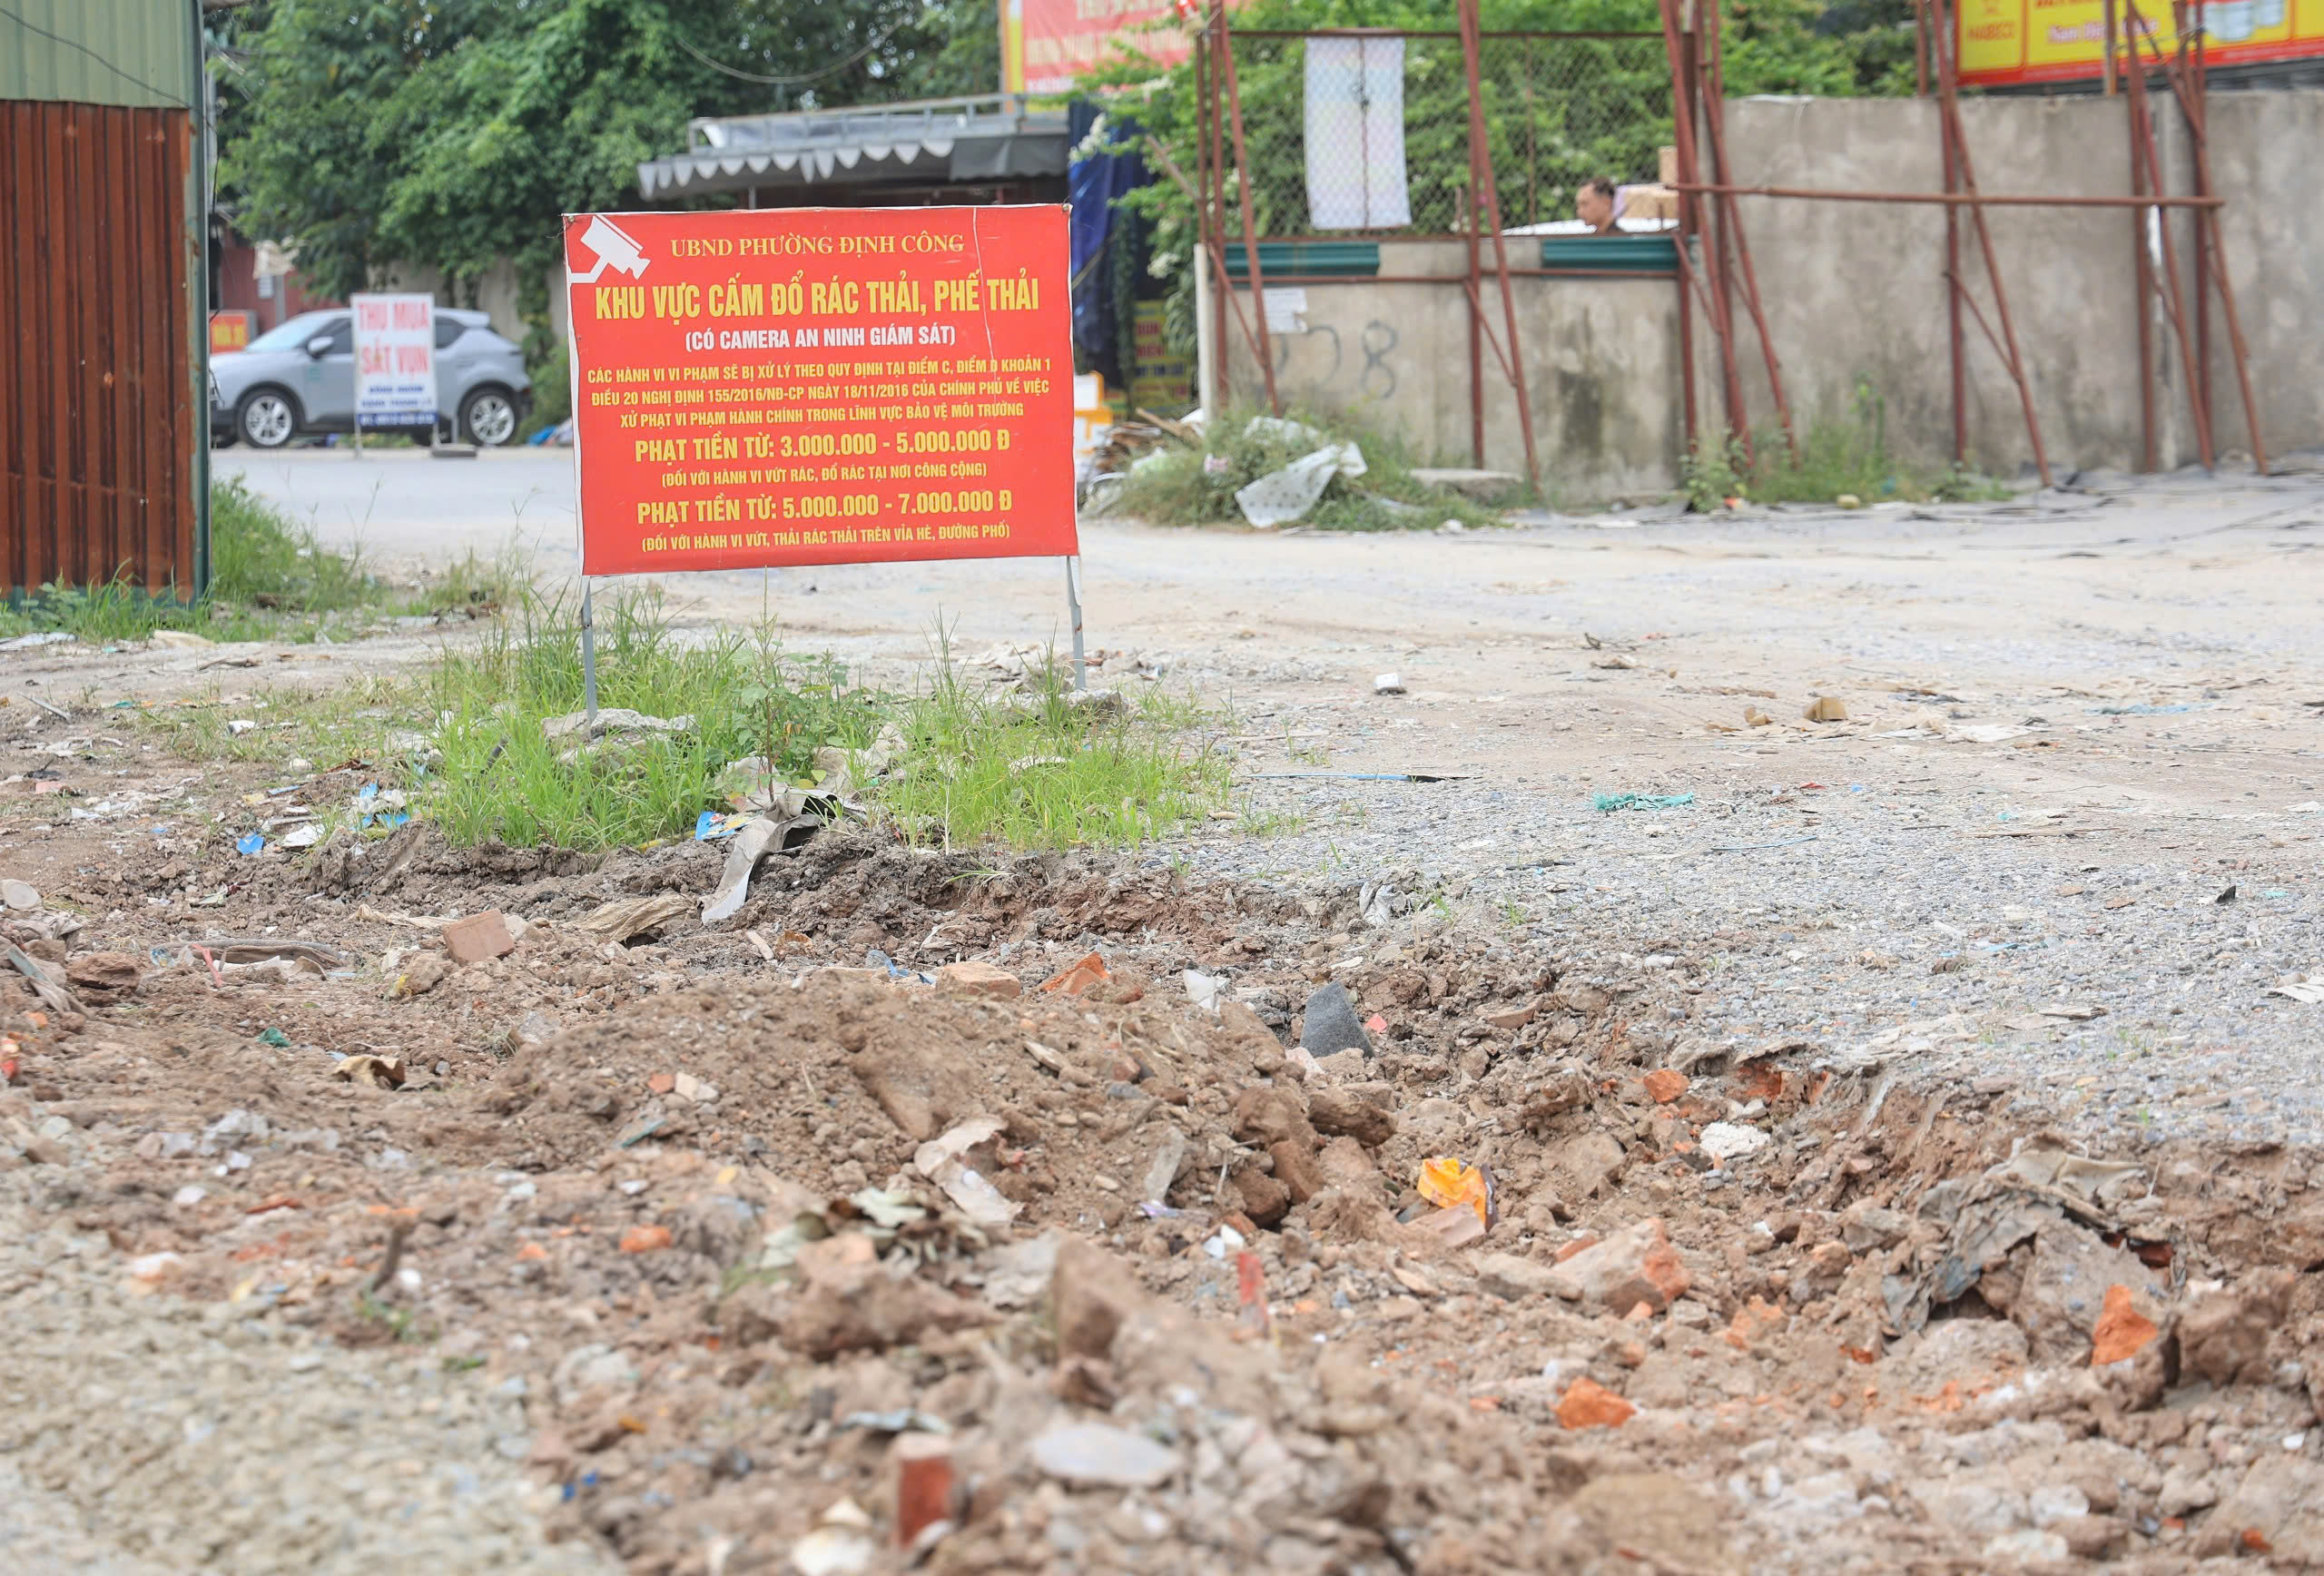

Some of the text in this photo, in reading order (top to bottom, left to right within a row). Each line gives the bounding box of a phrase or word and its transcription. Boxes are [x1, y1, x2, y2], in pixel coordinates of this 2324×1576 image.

[670, 230, 965, 259] UBND PHƯỜNG ĐỊNH CÔNG
[595, 266, 1039, 326] KHU VỰC CẤM ĐỔ RÁC THẢI, PHẾ THẢI
[358, 300, 430, 330] THU MUA
[684, 321, 956, 353] (CÓ CAMERA AN NINH GIÁM SÁT)
[587, 366, 613, 384] CÁC
[615, 366, 650, 383] HÀNH
[653, 367, 665, 382] VI
[667, 367, 681, 382] VI
[683, 366, 720, 384] PHẠM
[723, 362, 739, 380] SẼ
[741, 365, 754, 382] BỊ
[757, 360, 776, 379] XỬ
[776, 360, 792, 379] LÝ
[793, 363, 825, 379] THEO
[827, 362, 852, 379] QUY
[853, 361, 884, 379] ĐỊNH
[885, 360, 905, 379] TẠI
[907, 355, 940, 375] ĐIỂM
[941, 360, 954, 376] C,
[956, 354, 988, 374] ĐIỂM
[1000, 353, 1042, 373] KHOẢN
[1044, 358, 1051, 371] 1
[591, 376, 1050, 408] ĐIỀU 20 NGHỊ ĐỊNH 155/2016/NĐ-CP NGÀY 18/11/2016 CỦA CHÍNH PHỦ VỀ VIỆC
[620, 400, 1025, 430] XỬ PHẠT VI PHẠM HÀNH CHÍNH TRONG LĨNH VỰC BẢO VỆ MÔI TRƯỜNG
[635, 438, 688, 466] PHẠT
[693, 430, 738, 460] TIỀN
[743, 430, 775, 458] TỪ:
[780, 432, 877, 458] 3.000.000
[896, 428, 992, 454] 5.000.000
[996, 428, 1010, 451] Đ
[661, 459, 988, 488] (ĐỐI VỚI HÀNH VI VỨT RÁC, ĐỔ RÁC TẠI NƠI CÔNG CỘNG)
[637, 500, 690, 527] PHẠT
[694, 492, 741, 522] TIỀN
[745, 493, 777, 520] TỪ:
[783, 493, 880, 519] 5.000.000
[898, 488, 994, 515] 7.000.000
[998, 488, 1013, 512] Đ
[641, 519, 1010, 553] (ĐỐI VỚI HÀNH VI VỨT, THẢI RÁC THẢI TRÊN VỈA HÈ, ĐƯỜNG PHỐ)
